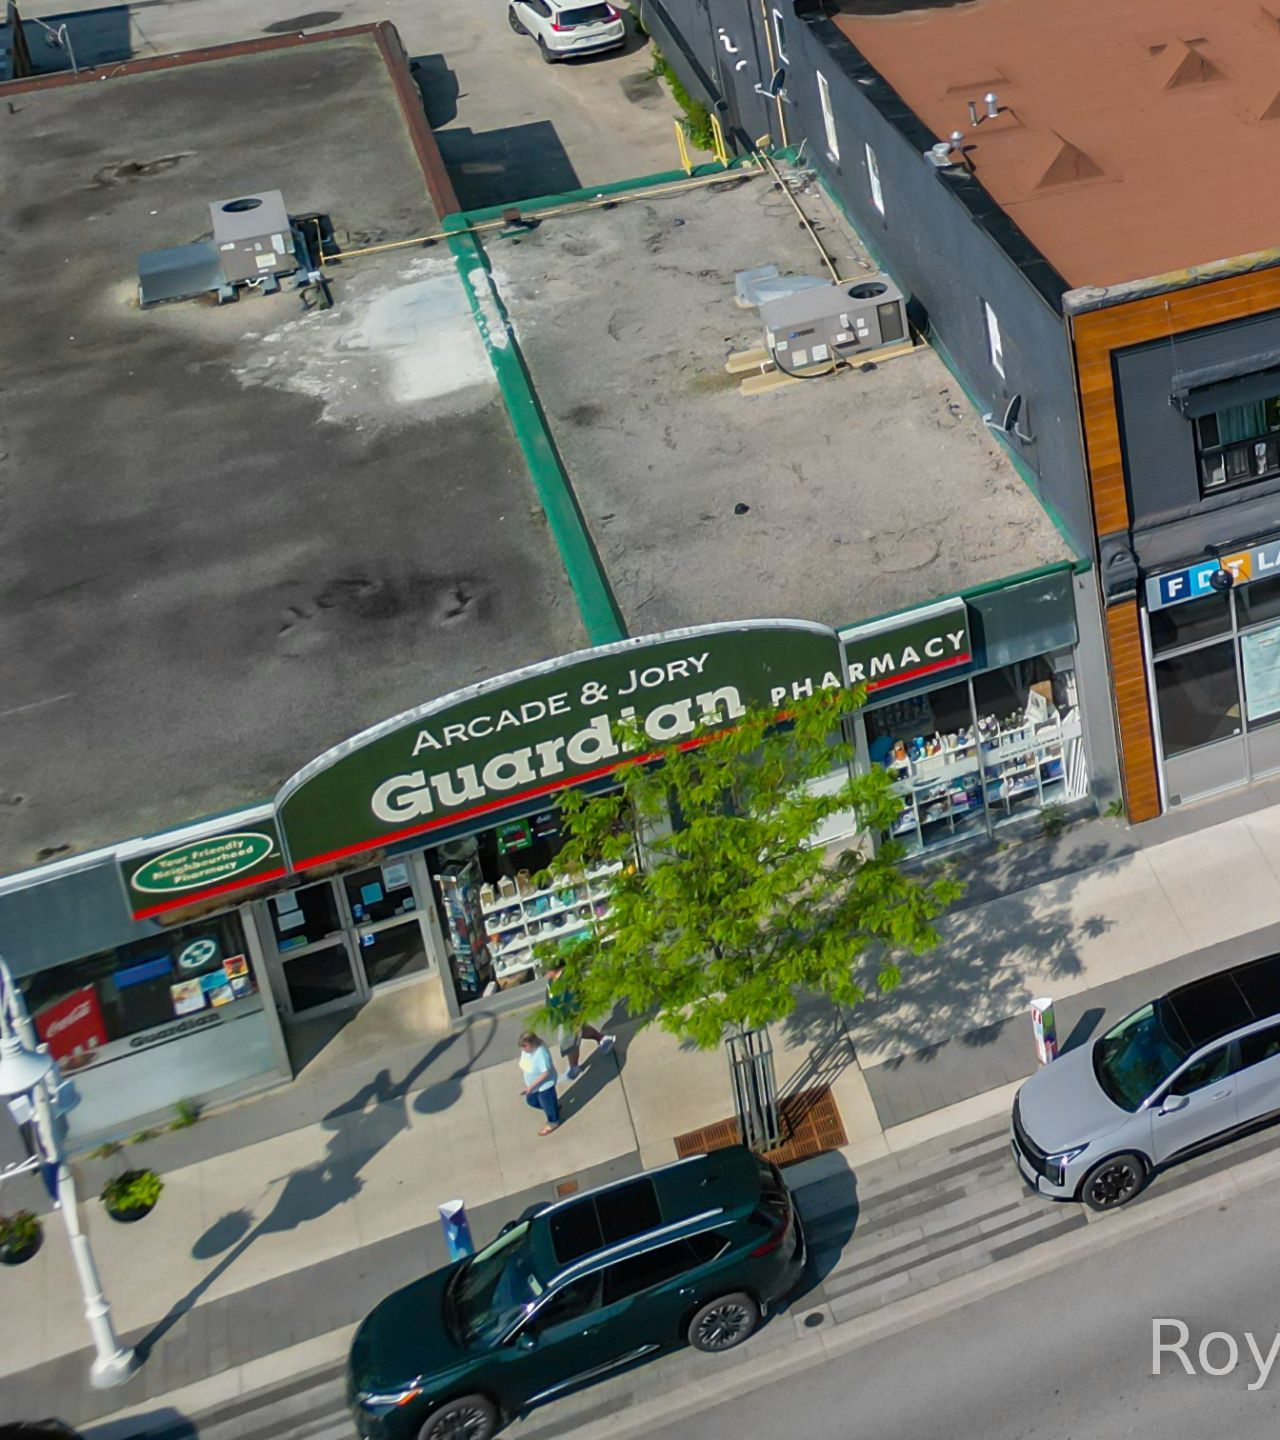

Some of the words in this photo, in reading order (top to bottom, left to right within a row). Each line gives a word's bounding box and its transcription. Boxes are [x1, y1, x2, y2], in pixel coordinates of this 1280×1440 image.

[411, 693, 570, 756] ARCADE
[580, 681, 609, 705] &
[618, 652, 711, 696] JORY
[371, 684, 747, 823] Guardian
[770, 629, 965, 707] PHARMACY
[152, 845, 254, 880] Neighbourhood
[158, 855, 187, 868] Your
[191, 839, 244, 859] Friendly
[174, 860, 237, 884] Pharmacy
[130, 1012, 221, 1048] Guardian
